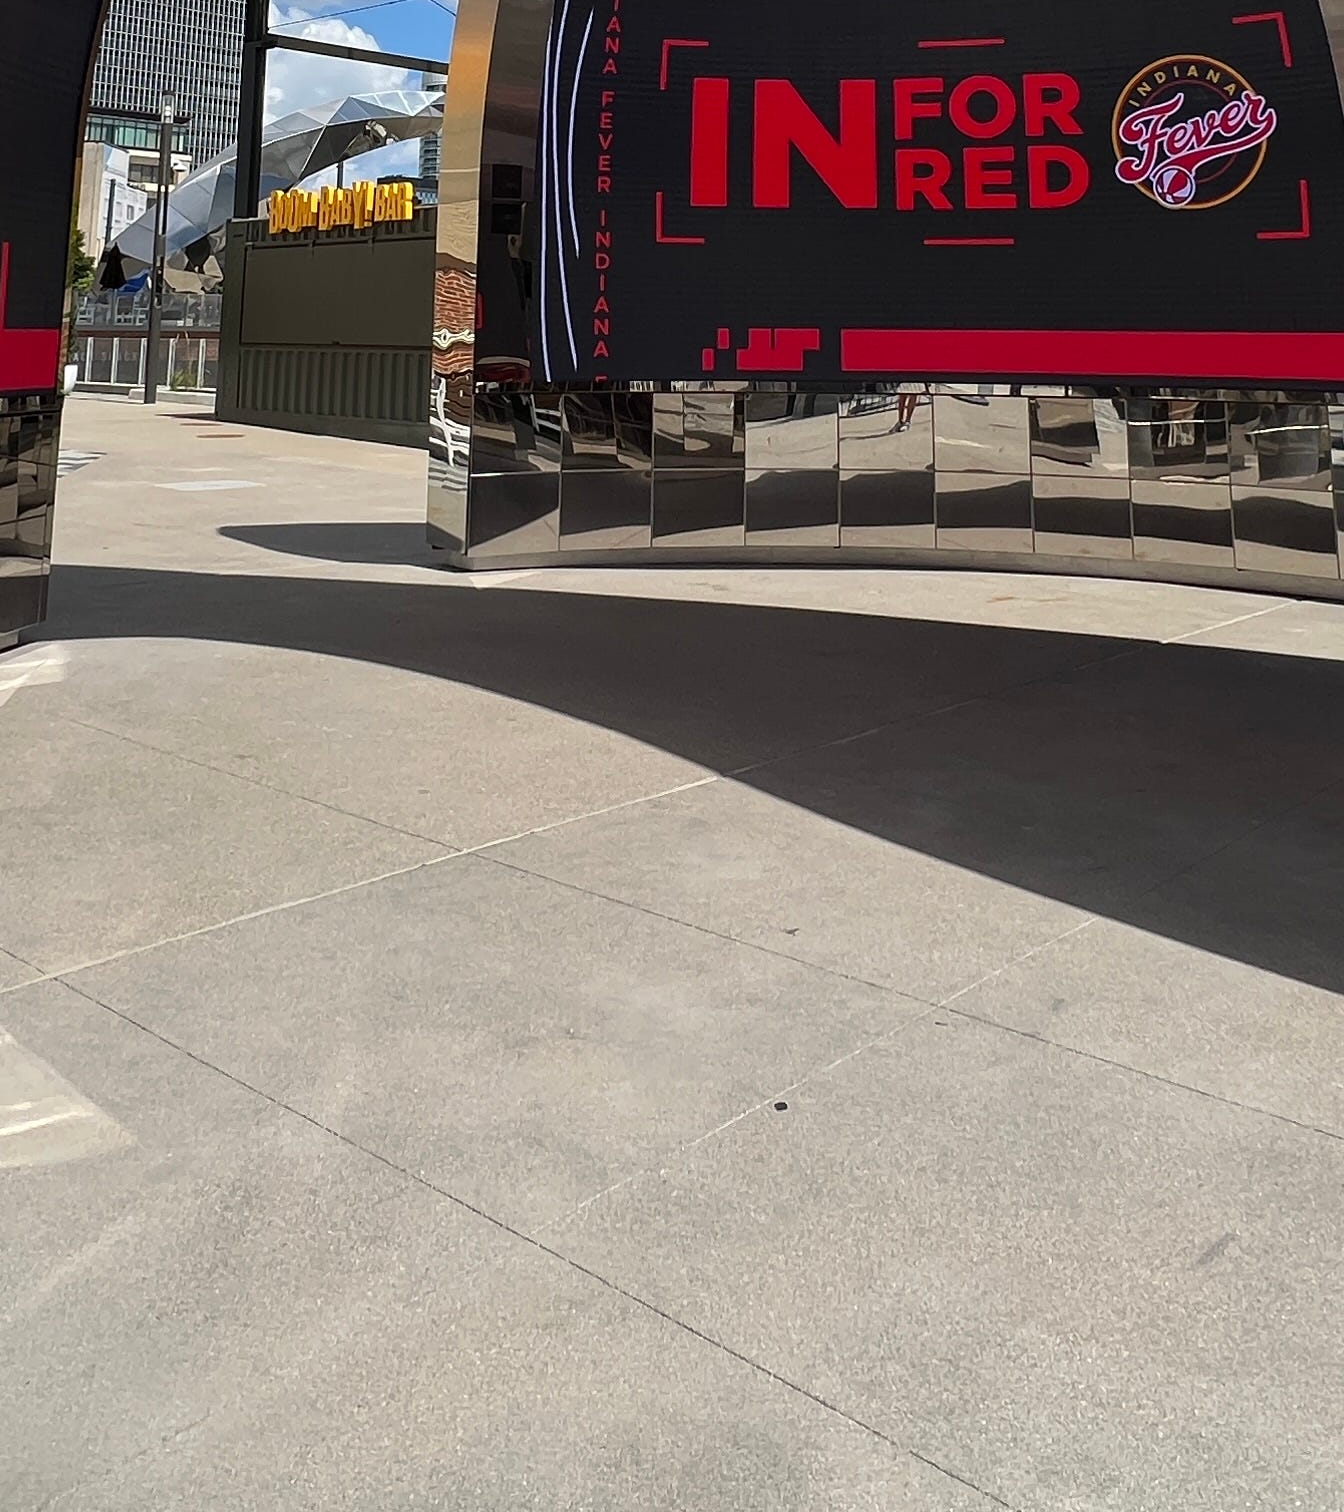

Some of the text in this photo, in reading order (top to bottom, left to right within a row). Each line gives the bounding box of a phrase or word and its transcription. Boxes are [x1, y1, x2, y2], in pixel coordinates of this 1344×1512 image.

[892, 73, 1084, 141] FOR
[1128, 64, 1238, 108] INDIANA
[597, 90, 616, 194] FEVER
[690, 77, 877, 209] IN
[894, 144, 1091, 211] RED
[1115, 91, 1277, 185] Fever
[374, 181, 414, 223] BAR
[593, 209, 612, 359] INDIANA
